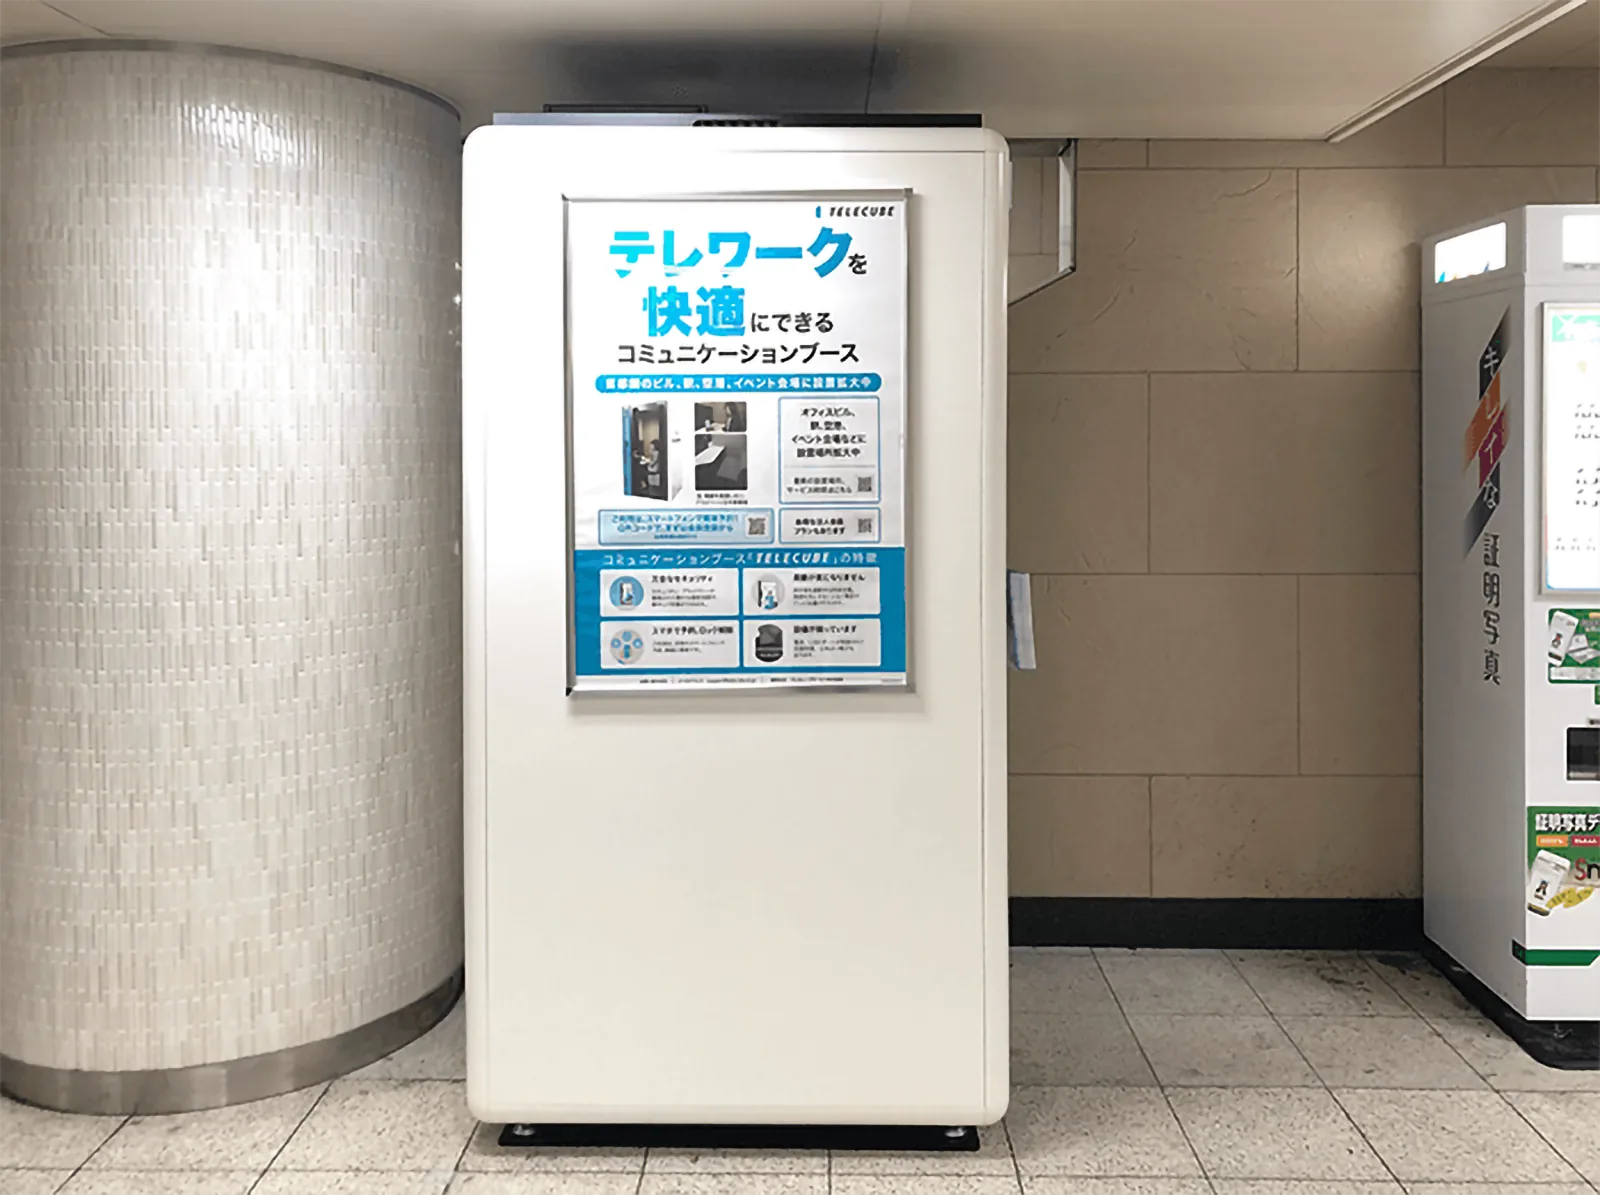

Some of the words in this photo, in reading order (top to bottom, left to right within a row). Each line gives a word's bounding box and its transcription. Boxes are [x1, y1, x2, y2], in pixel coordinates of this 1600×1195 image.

[829, 206, 895, 217] TELECUBE
[609, 227, 868, 278] テレワークを
[642, 285, 834, 337] 快適にできる
[618, 343, 859, 364] コミュニケーションブース
